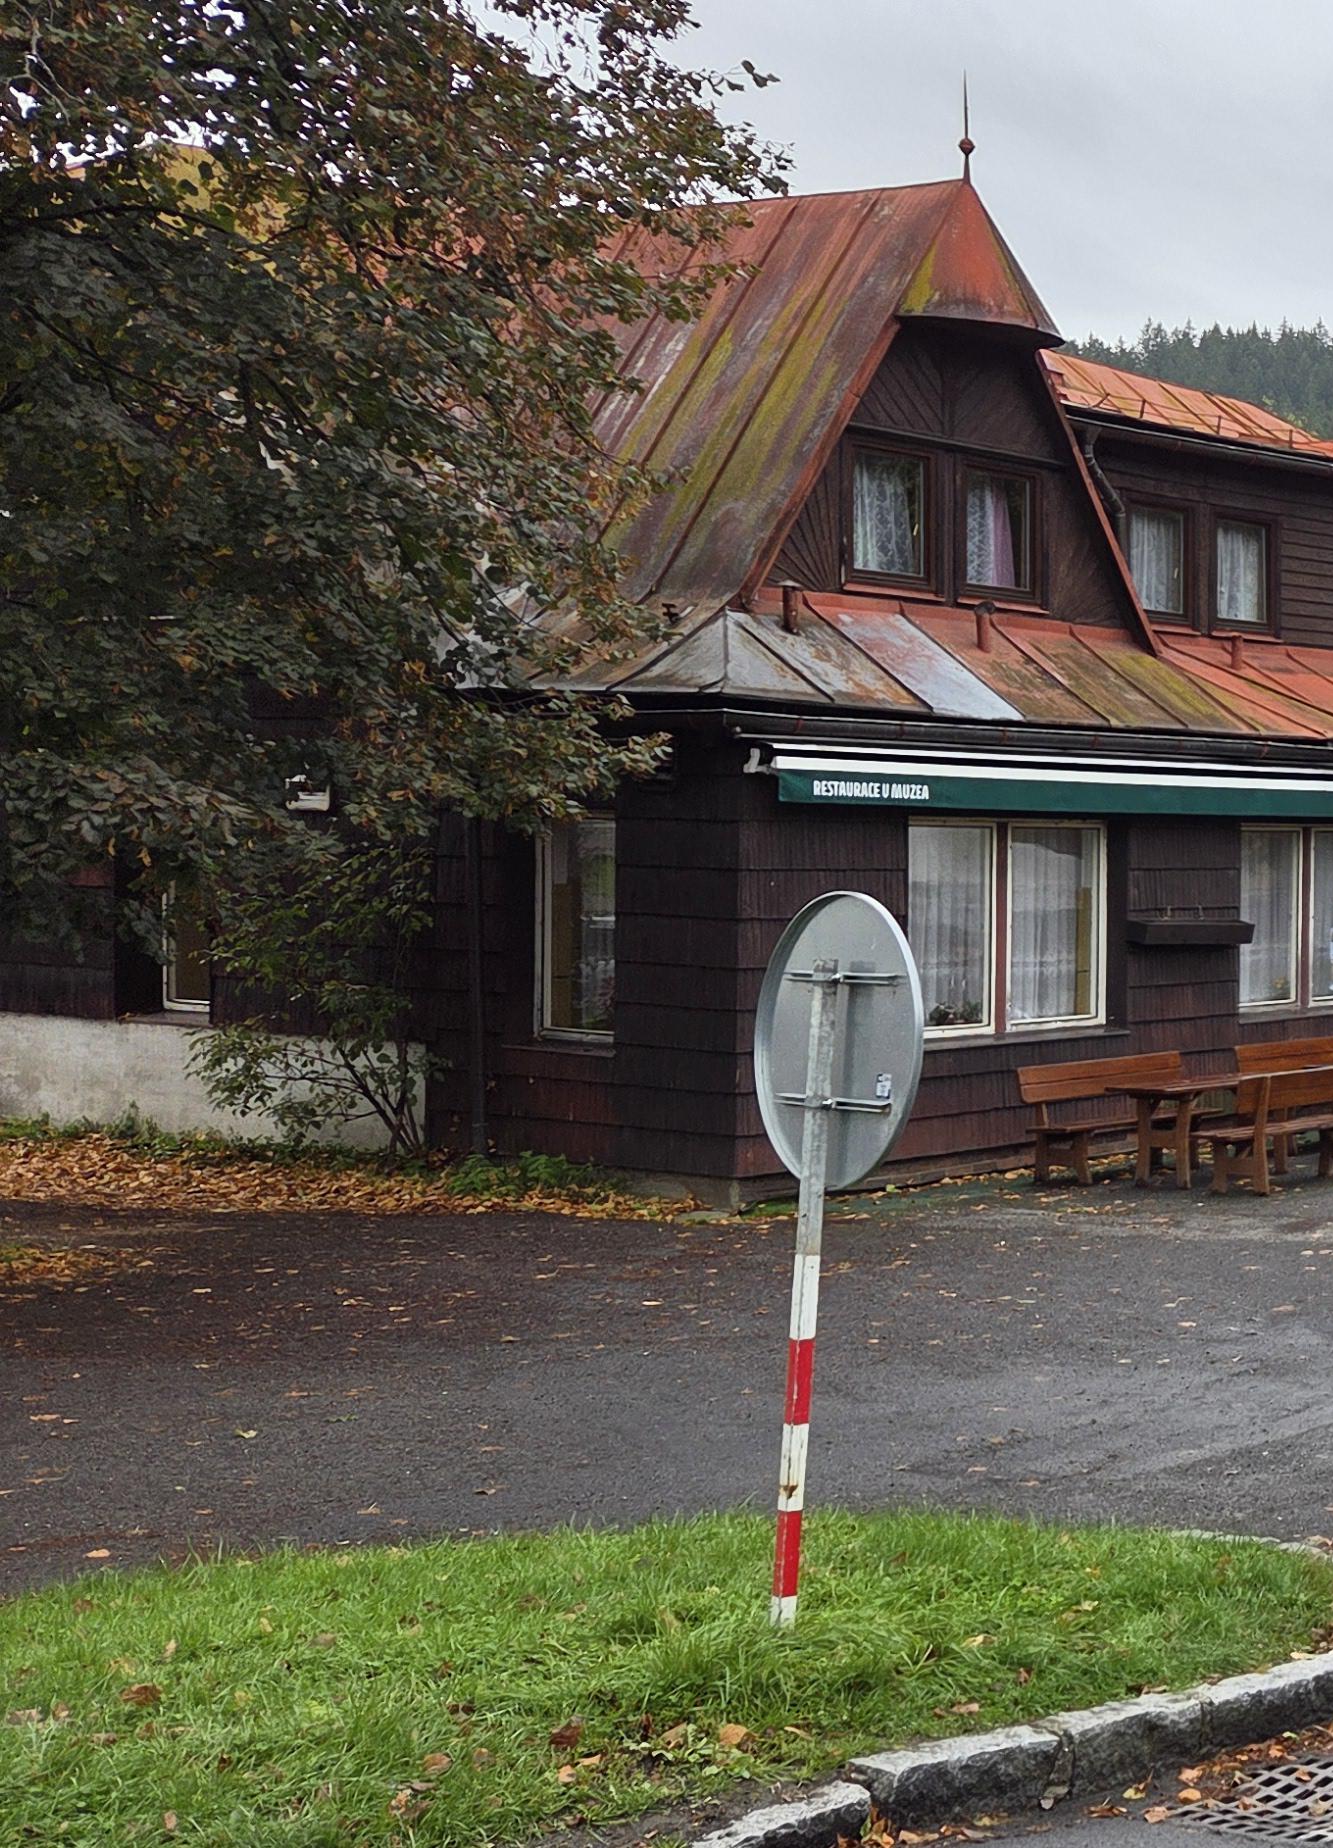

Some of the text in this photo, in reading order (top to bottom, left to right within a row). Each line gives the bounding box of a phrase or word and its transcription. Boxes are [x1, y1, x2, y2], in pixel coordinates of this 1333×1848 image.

[813, 780, 929, 800] RESTAURACE U MUZEA
